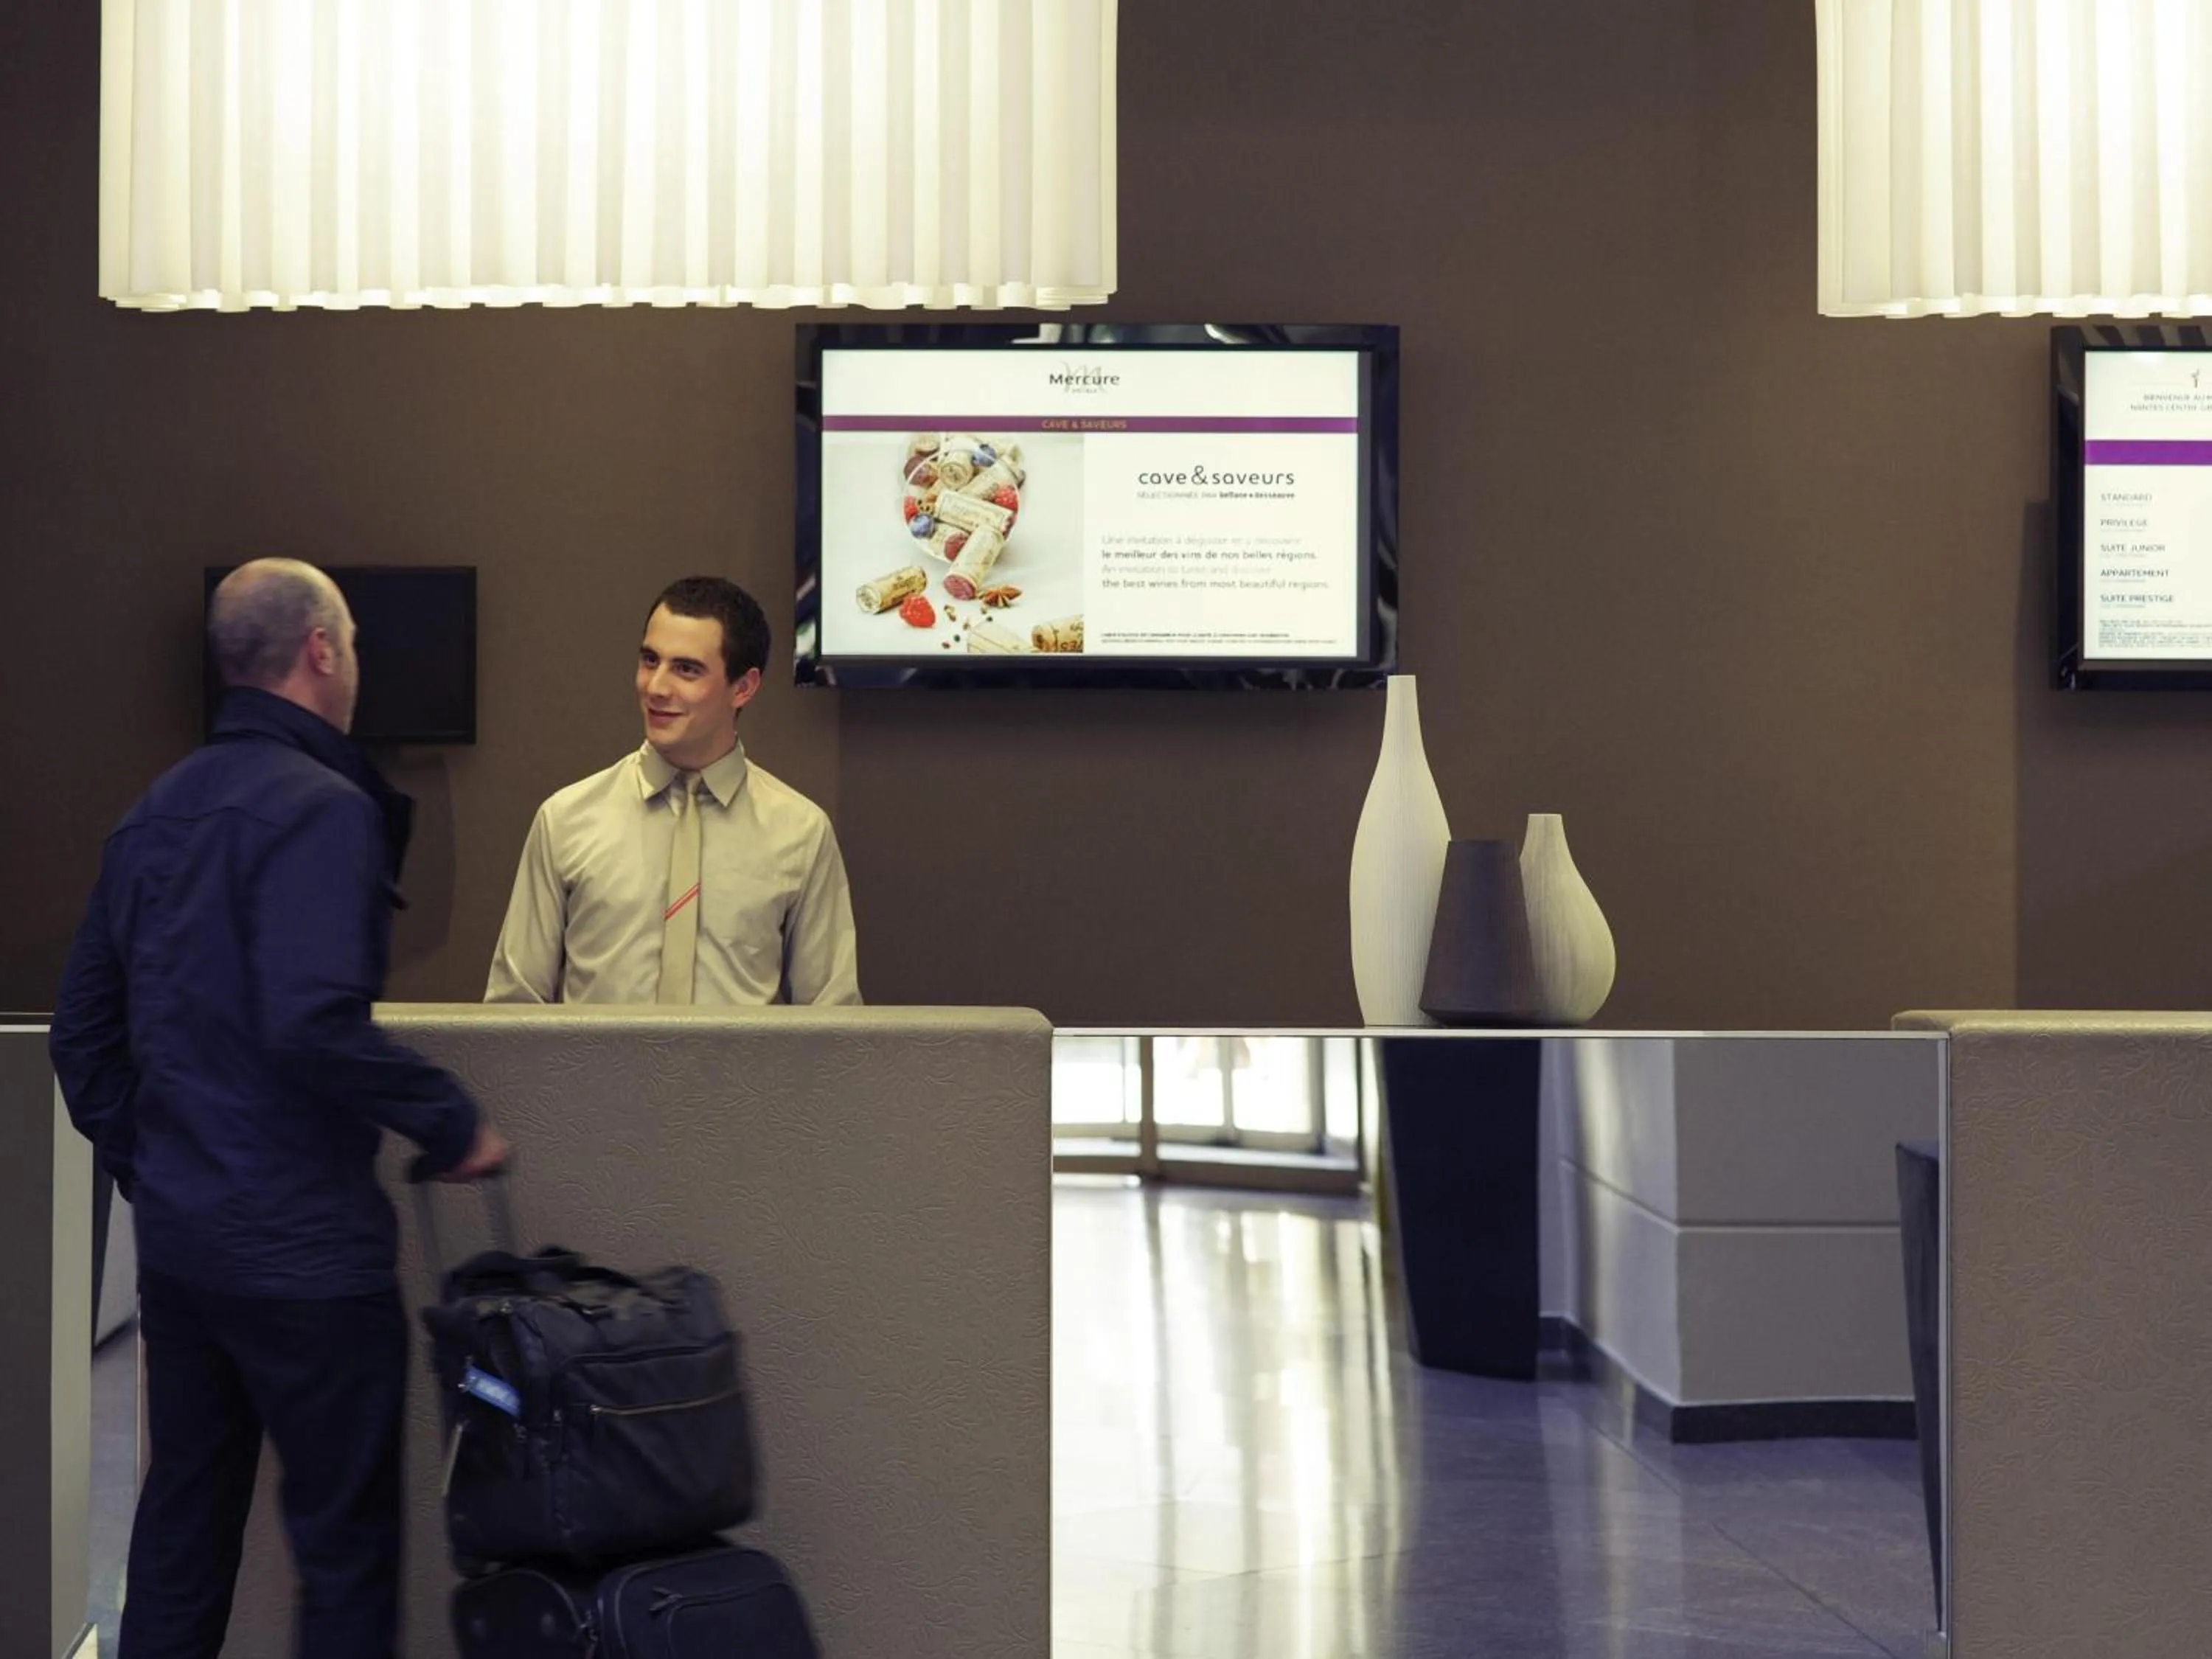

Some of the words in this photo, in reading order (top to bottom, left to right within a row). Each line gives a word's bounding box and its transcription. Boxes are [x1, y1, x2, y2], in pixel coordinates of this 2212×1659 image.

[1048, 373, 1120, 385] Mercure
[1041, 419, 1068, 429] CAVE
[1080, 419, 1127, 429] SAVEURS
[2101, 493, 2152, 501] STANDARD
[2099, 543, 2125, 552] SUITE
[2131, 543, 2166, 552] JUNIOR
[1102, 549, 1111, 559] le
[1114, 549, 1156, 559] meilleur
[1160, 550, 1178, 559] des
[1182, 551, 1202, 559] vins
[1205, 550, 1217, 559] de
[1242, 550, 1273, 559] belles
[2100, 568, 2169, 577] APPARTEMENT
[1102, 578, 1120, 588] the
[1123, 579, 1145, 588] best
[1181, 578, 1207, 588] from
[1239, 579, 1286, 588] beautiful
[2099, 594, 2125, 602] SUITE
[2128, 594, 2174, 602] PRESTIGE
